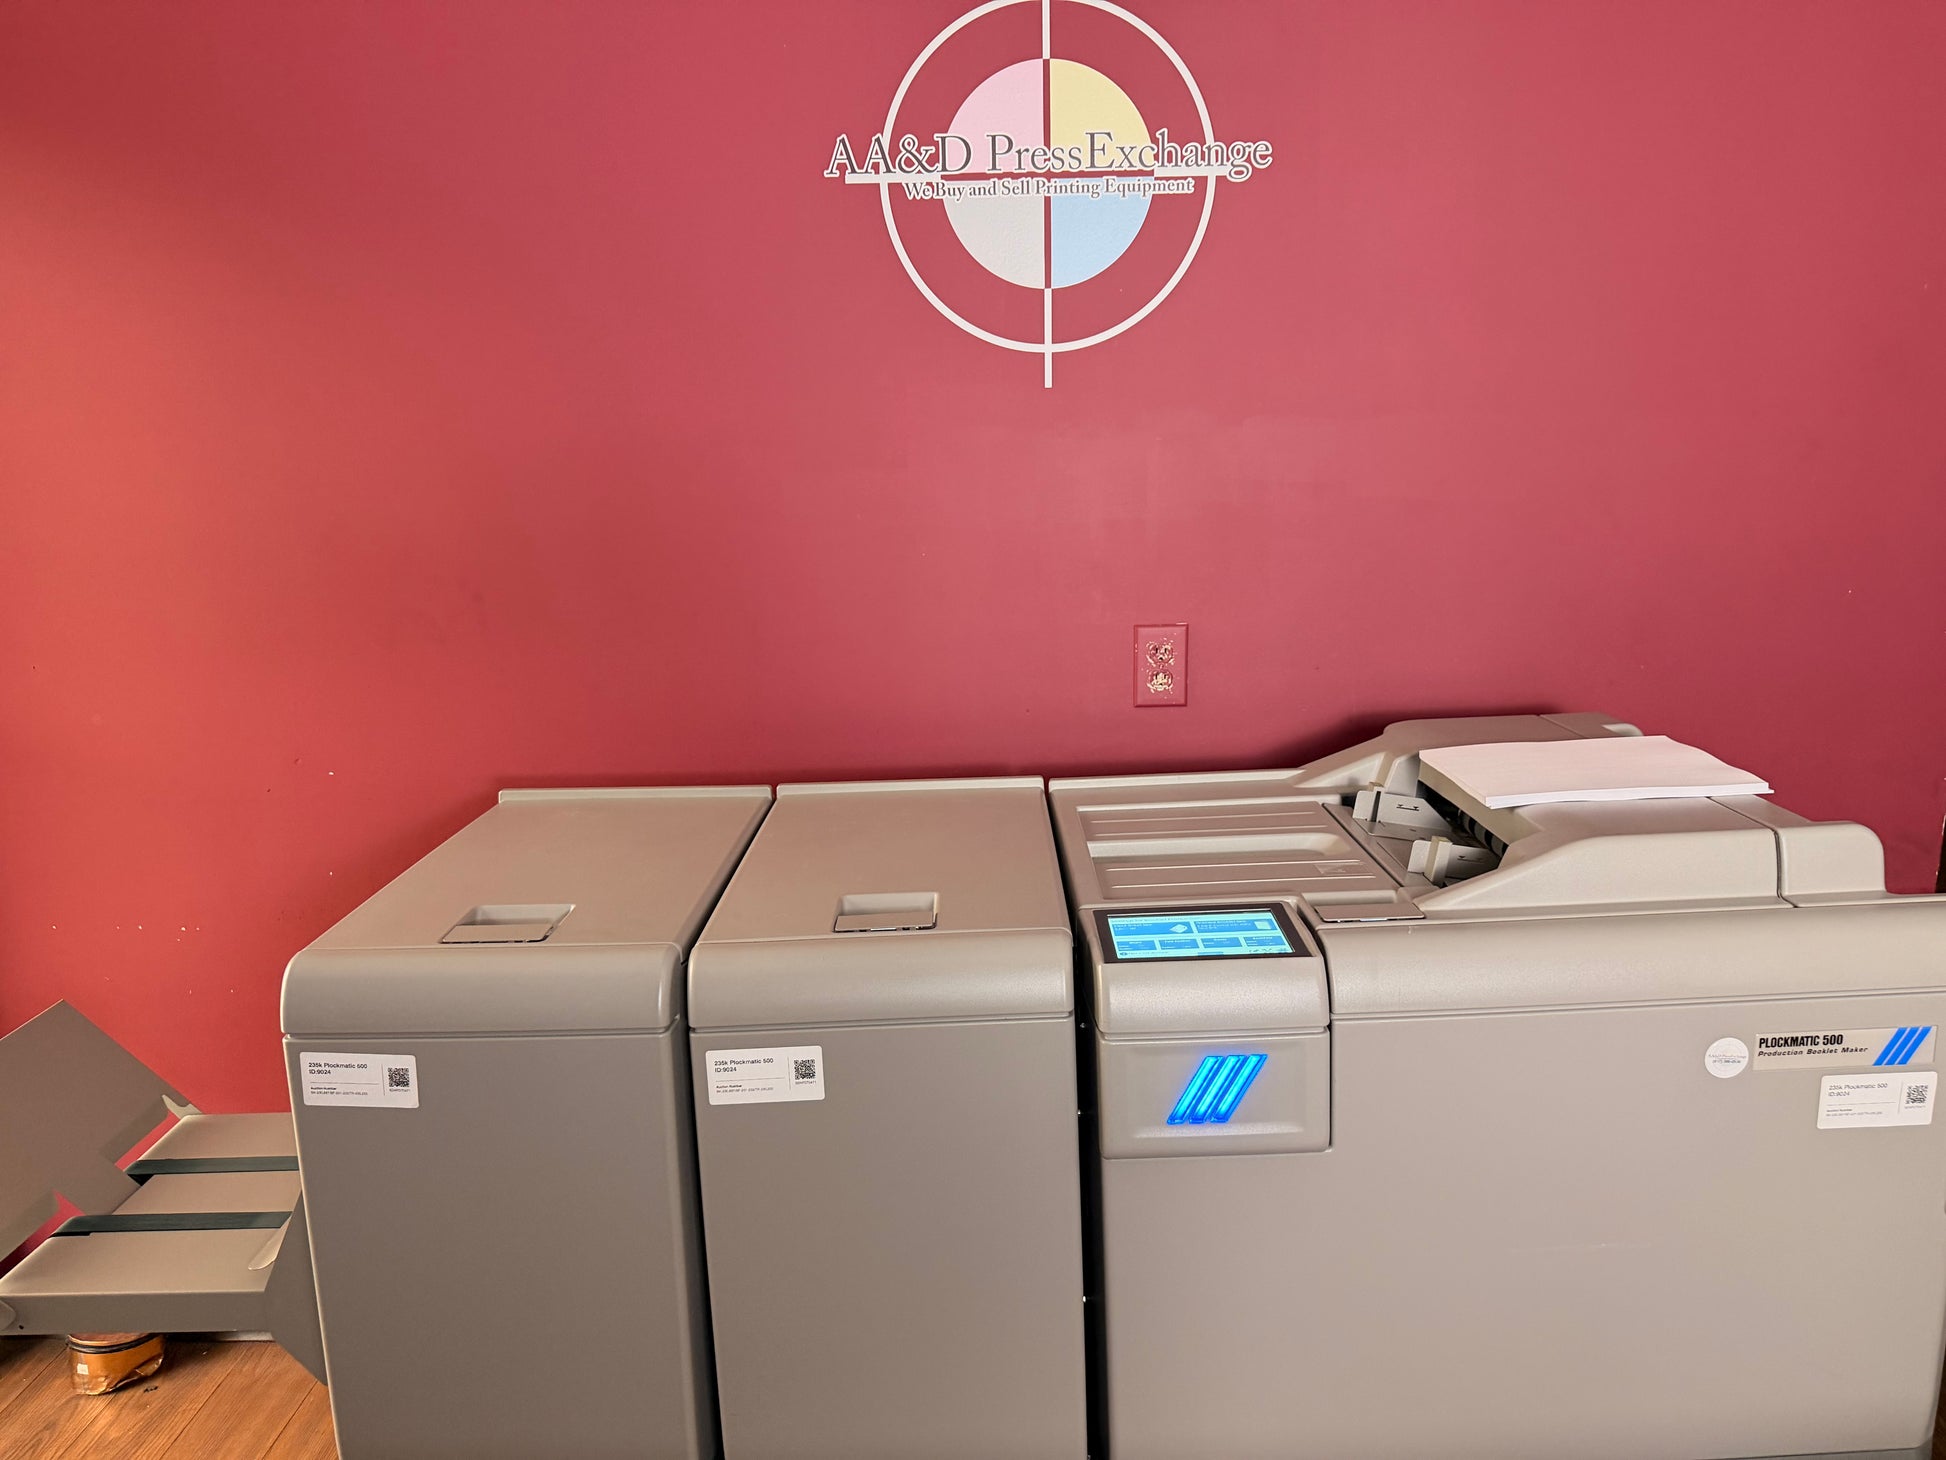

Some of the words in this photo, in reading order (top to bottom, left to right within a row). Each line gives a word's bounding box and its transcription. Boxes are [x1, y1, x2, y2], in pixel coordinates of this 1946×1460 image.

[825, 134, 972, 176] AA&D
[986, 129, 1272, 181] PressExchange
[904, 182, 931, 198] We
[935, 182, 966, 201] Buy
[969, 181, 997, 196] and
[1001, 179, 1030, 195] Sell
[1035, 178, 1100, 199] Printing
[1103, 177, 1194, 198] Equipment
[1758, 1035, 1820, 1048] PLOCKMATIC
[1822, 1034, 1843, 1046] 500
